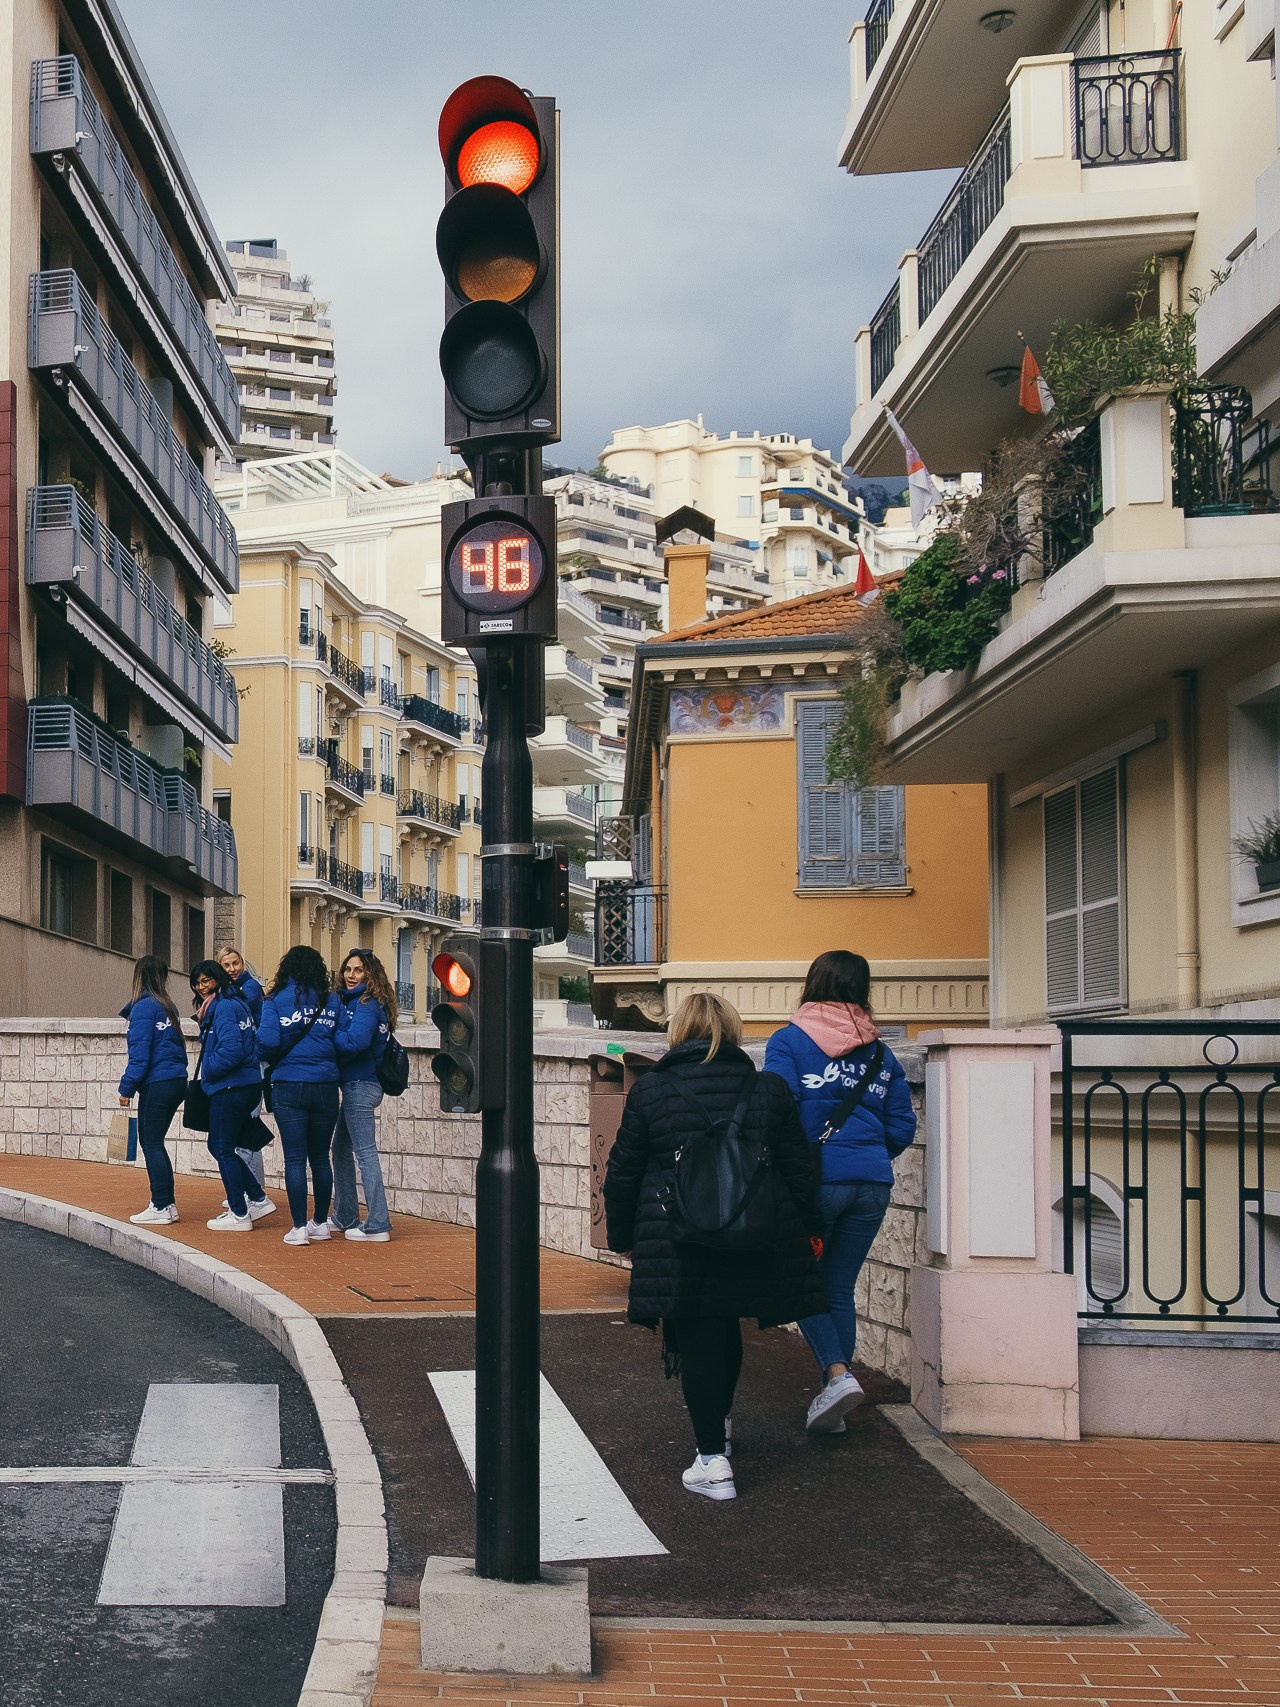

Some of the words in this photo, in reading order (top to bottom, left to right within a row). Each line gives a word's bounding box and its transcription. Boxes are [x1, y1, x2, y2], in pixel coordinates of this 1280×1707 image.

[462, 537, 530, 592] 46
[840, 1060, 856, 1073] La
[879, 1069, 891, 1082] de
